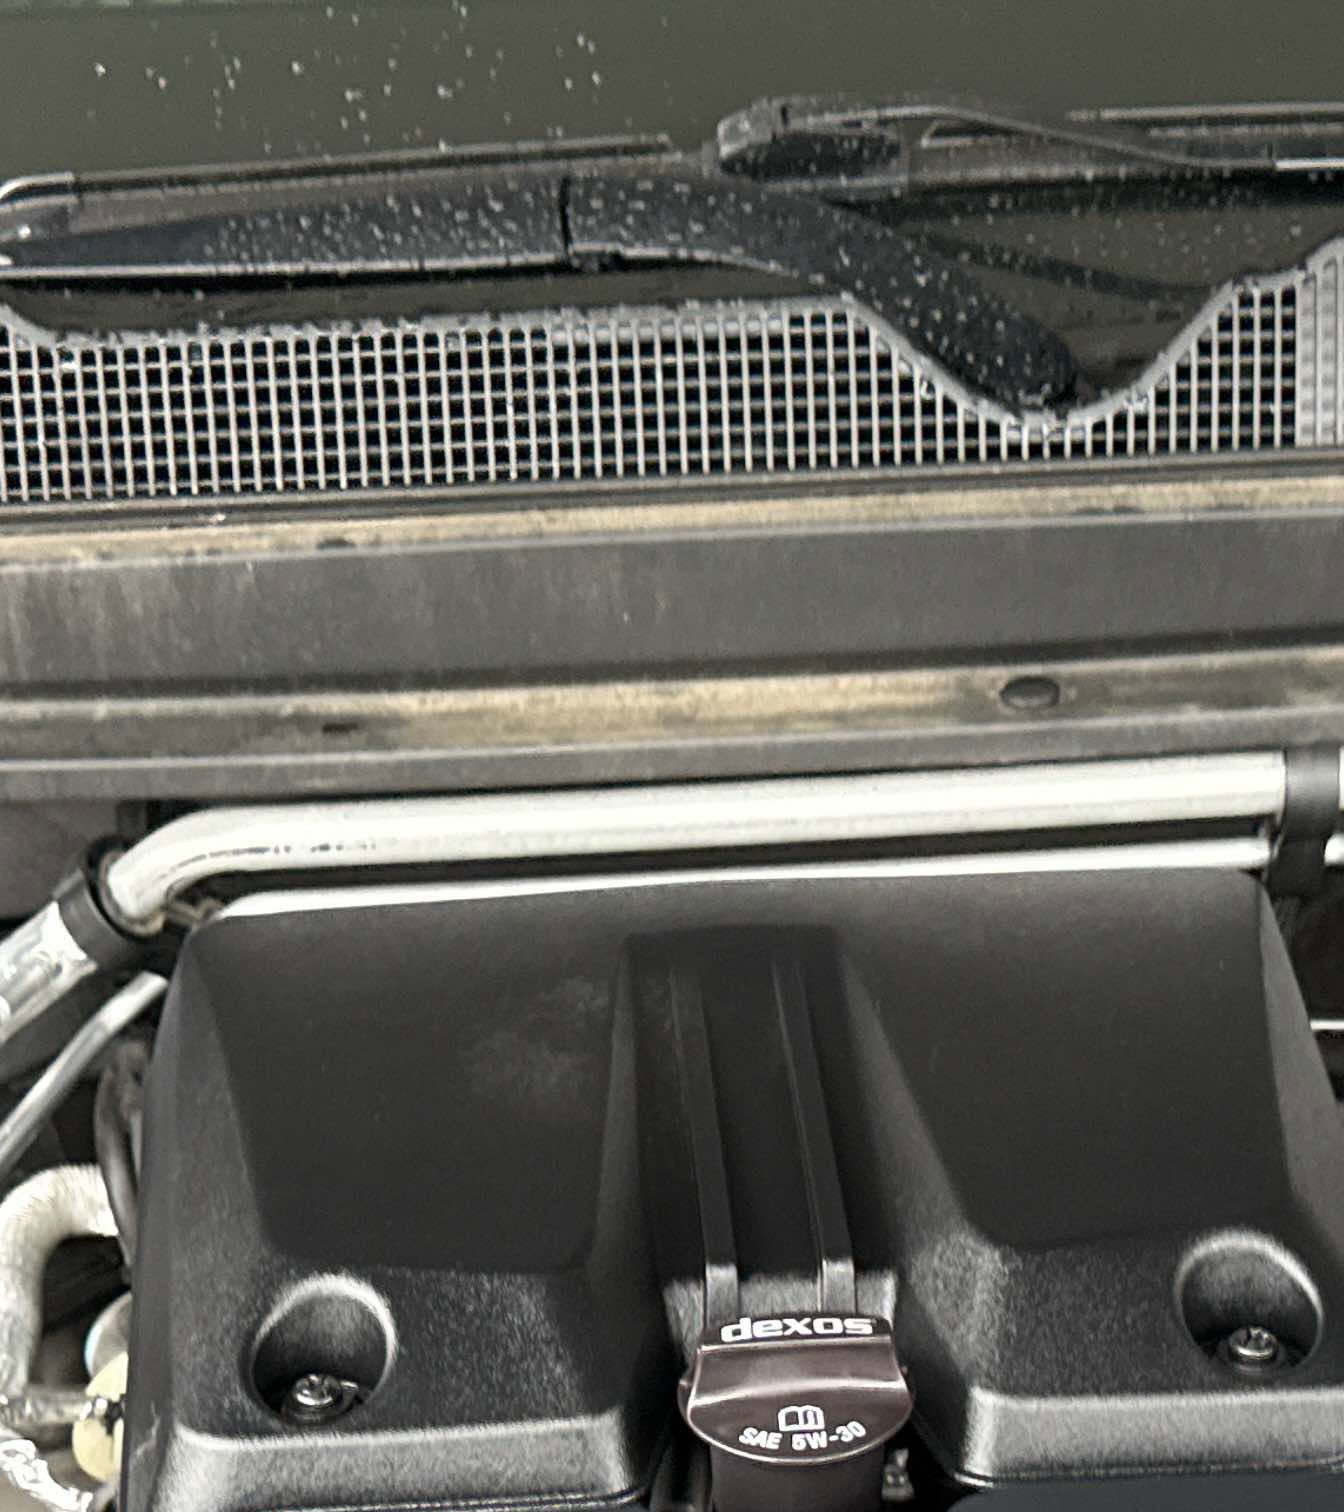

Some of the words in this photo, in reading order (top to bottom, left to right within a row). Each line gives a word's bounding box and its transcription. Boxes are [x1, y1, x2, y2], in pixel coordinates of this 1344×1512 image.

[721, 1317, 873, 1343] dexos
[739, 1427, 782, 1450] SAE
[791, 1421, 867, 1451] 5W-30
